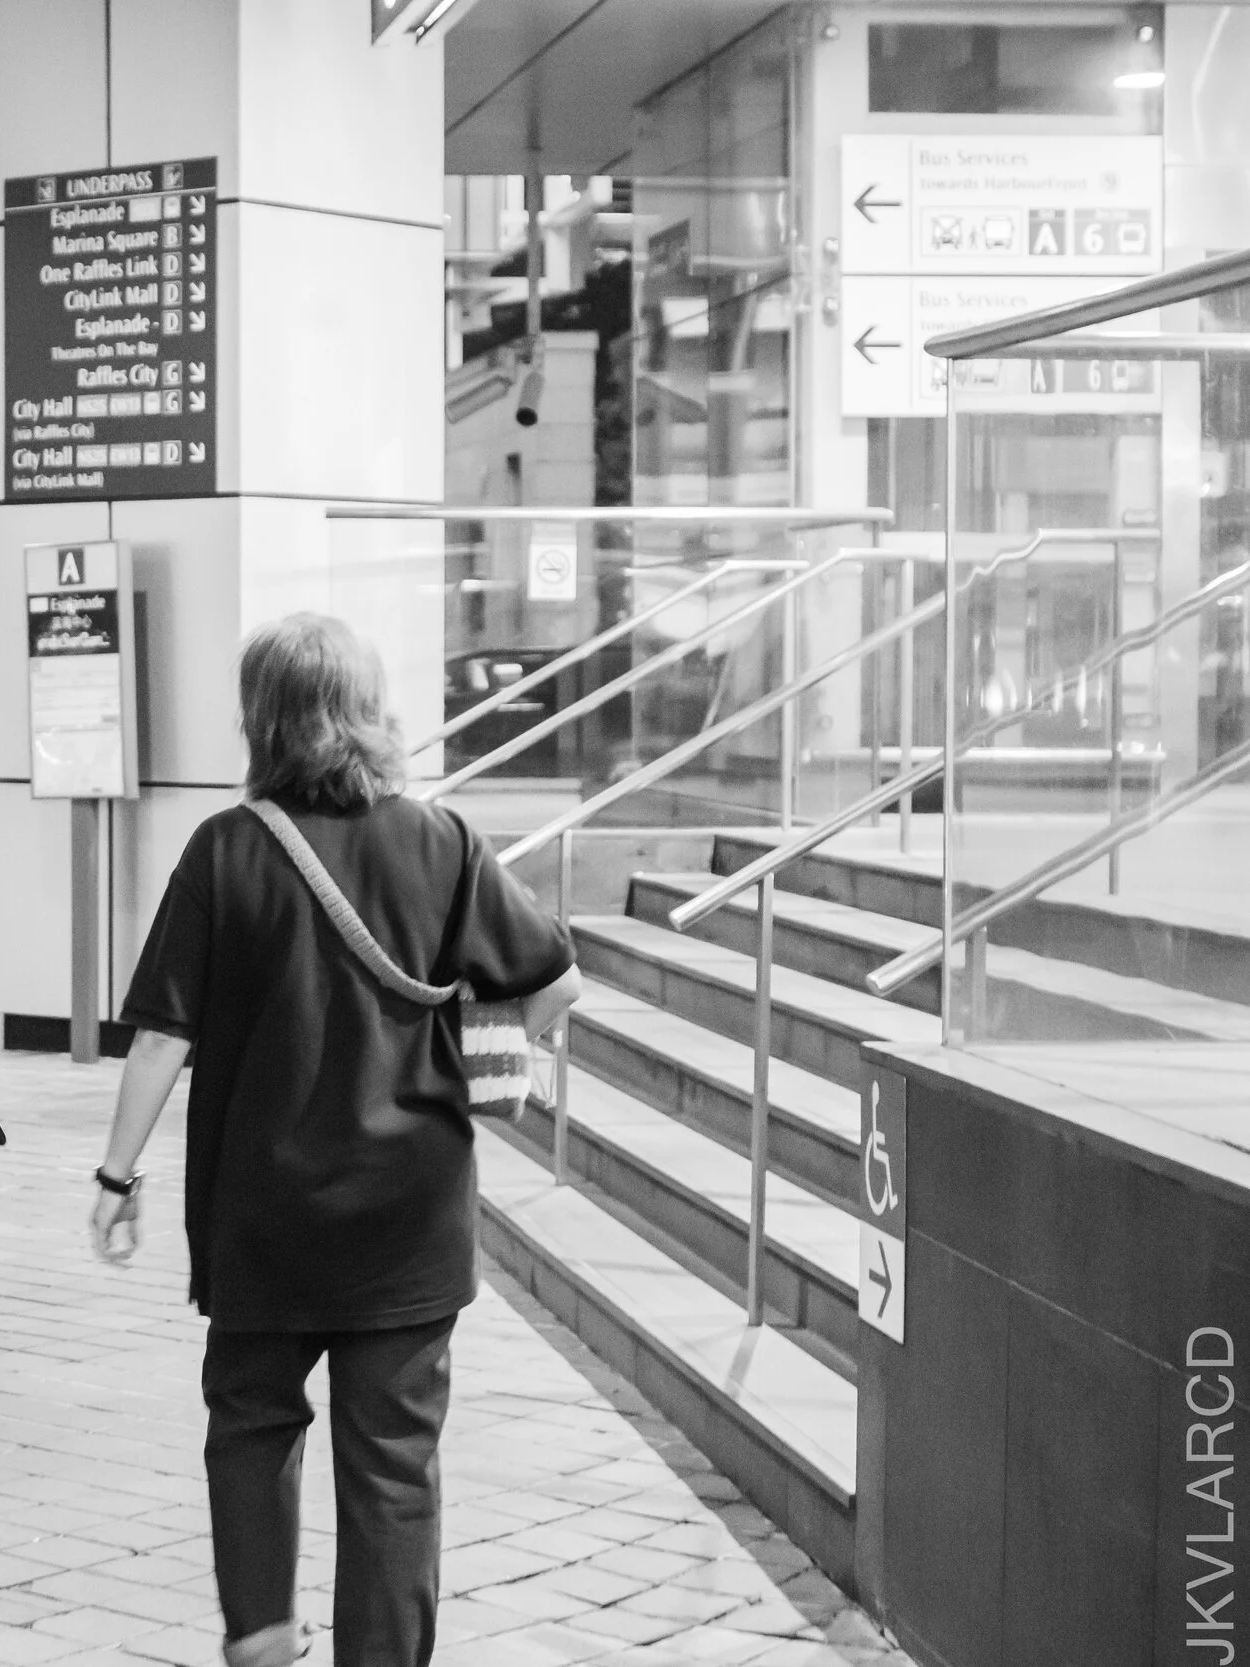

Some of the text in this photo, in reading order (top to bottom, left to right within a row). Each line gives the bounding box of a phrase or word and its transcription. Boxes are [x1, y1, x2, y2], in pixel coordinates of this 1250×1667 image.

[919, 148, 1029, 167] Bus Services
[66, 170, 154, 198] UNDERPASS
[50, 200, 126, 230] Esplanade
[52, 232, 105, 255] Marina
[106, 230, 159, 252] Square
[1032, 221, 1105, 255] A 6
[39, 265, 71, 286] One
[72, 258, 124, 282] Raffles
[125, 255, 159, 277] Link
[63, 286, 124, 313] CityLink
[125, 282, 159, 305] Mall
[919, 290, 951, 307] Bus
[75, 312, 150, 340] Esplanade
[77, 364, 128, 388] Raffles
[129, 363, 159, 387] City
[12, 398, 41, 422] City
[42, 396, 74, 418] Hall
[12, 448, 41, 472] City
[42, 445, 74, 468] Hall
[60, 551, 81, 584] A
